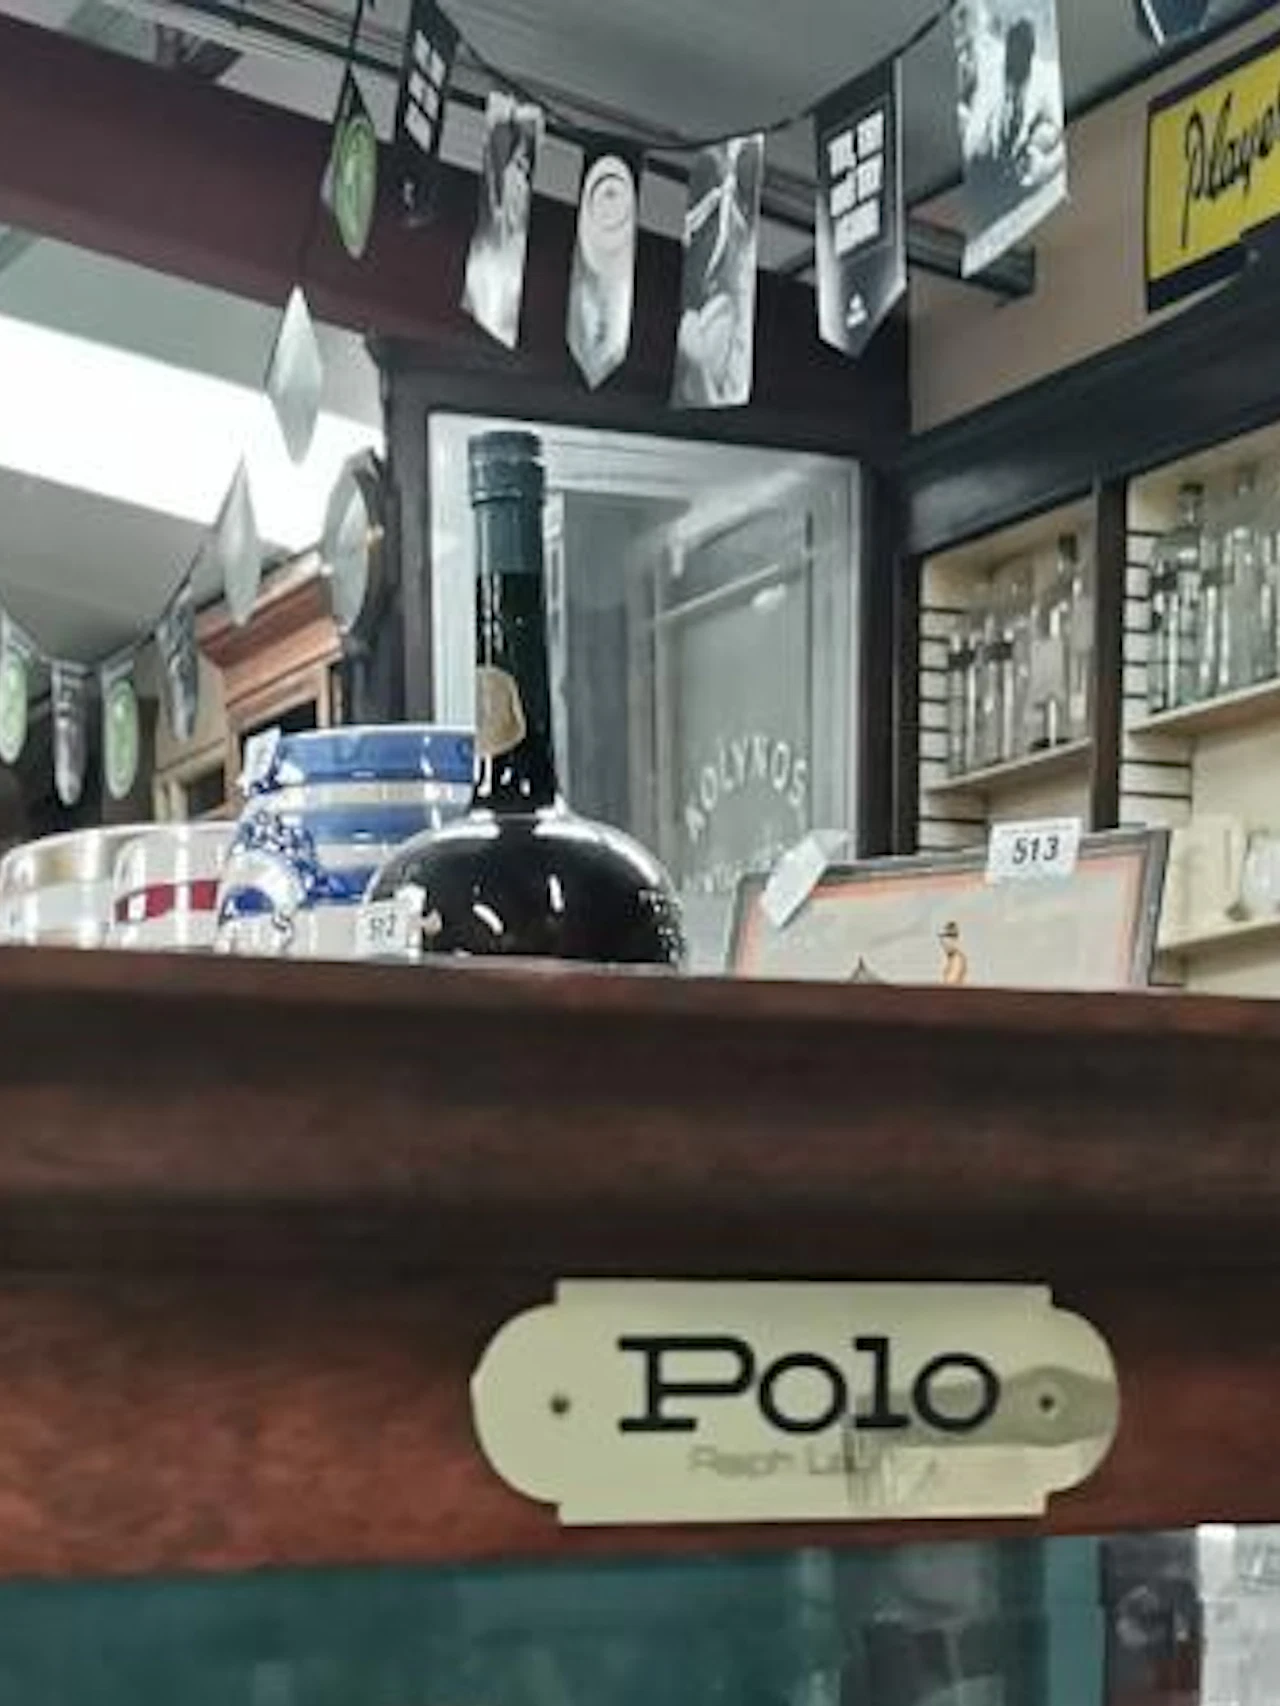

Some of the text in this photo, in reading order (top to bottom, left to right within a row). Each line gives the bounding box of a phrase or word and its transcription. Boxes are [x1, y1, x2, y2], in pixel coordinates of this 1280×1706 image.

[684, 733, 807, 843] KOLYNOS
[1011, 834, 1060, 865] 513
[617, 1336, 1001, 1434] Polo
